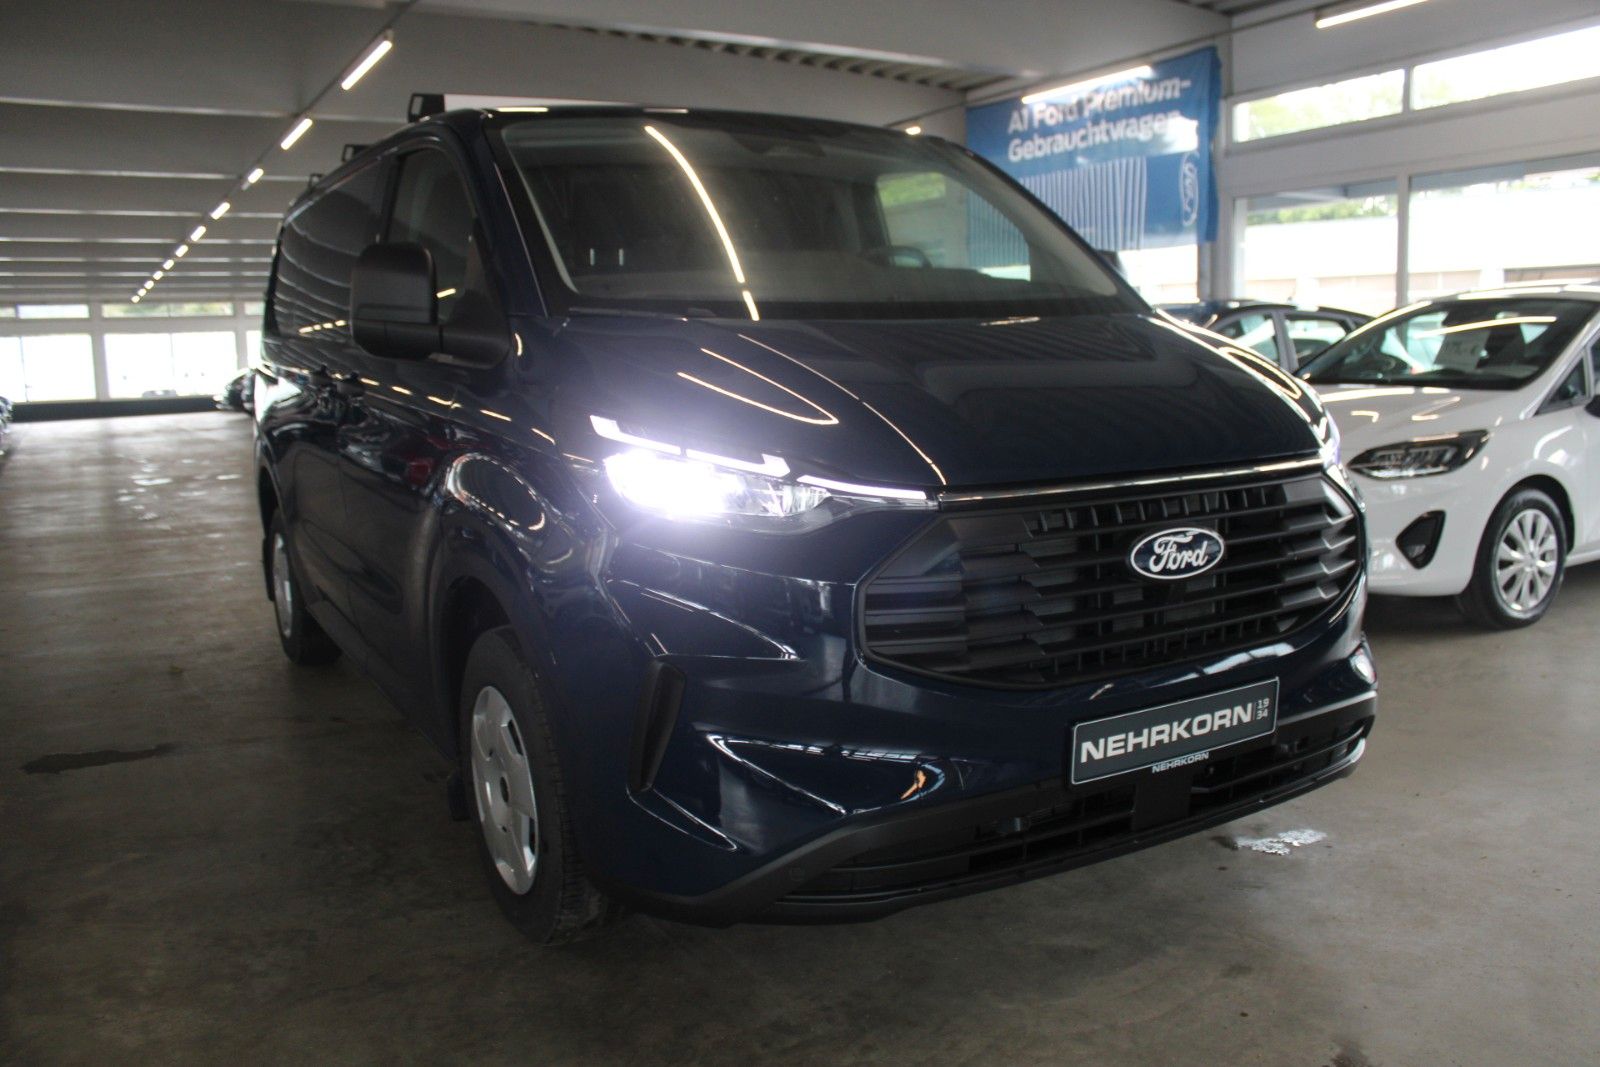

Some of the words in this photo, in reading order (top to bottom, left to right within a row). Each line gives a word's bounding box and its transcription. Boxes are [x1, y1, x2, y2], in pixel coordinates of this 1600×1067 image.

[1032, 96, 1079, 128] Ford
[1083, 76, 1191, 117] Premium-
[1149, 531, 1208, 573] Ford
[1080, 703, 1252, 763] NEHRKORN
[1151, 751, 1210, 774] NEHRKORN
